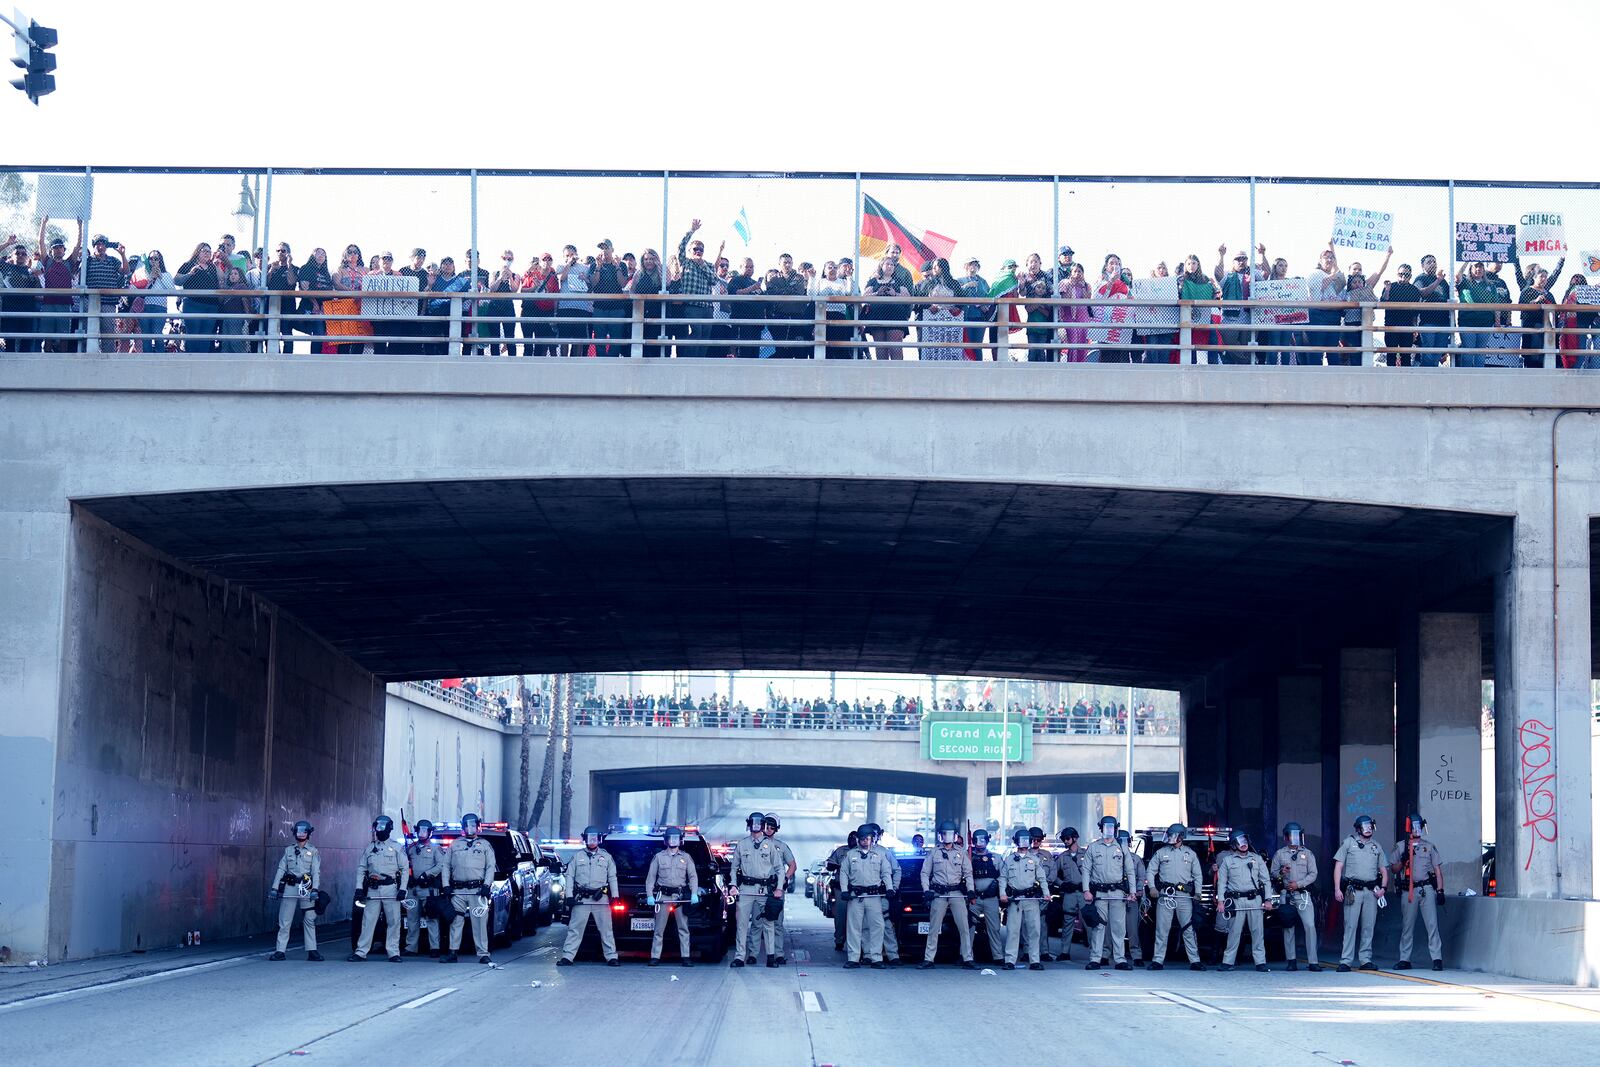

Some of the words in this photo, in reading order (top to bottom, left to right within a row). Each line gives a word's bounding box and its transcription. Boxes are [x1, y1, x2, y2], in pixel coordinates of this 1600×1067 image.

[1335, 206, 1346, 215] MI
[1520, 213, 1562, 226] CHINGA
[1525, 240, 1560, 251] MAGA
[940, 728, 980, 739] Grand
[987, 728, 1012, 739] Ave
[939, 745, 979, 754] SECOND
[1435, 769, 1457, 785] SE
[1430, 789, 1472, 801] PUEDE
